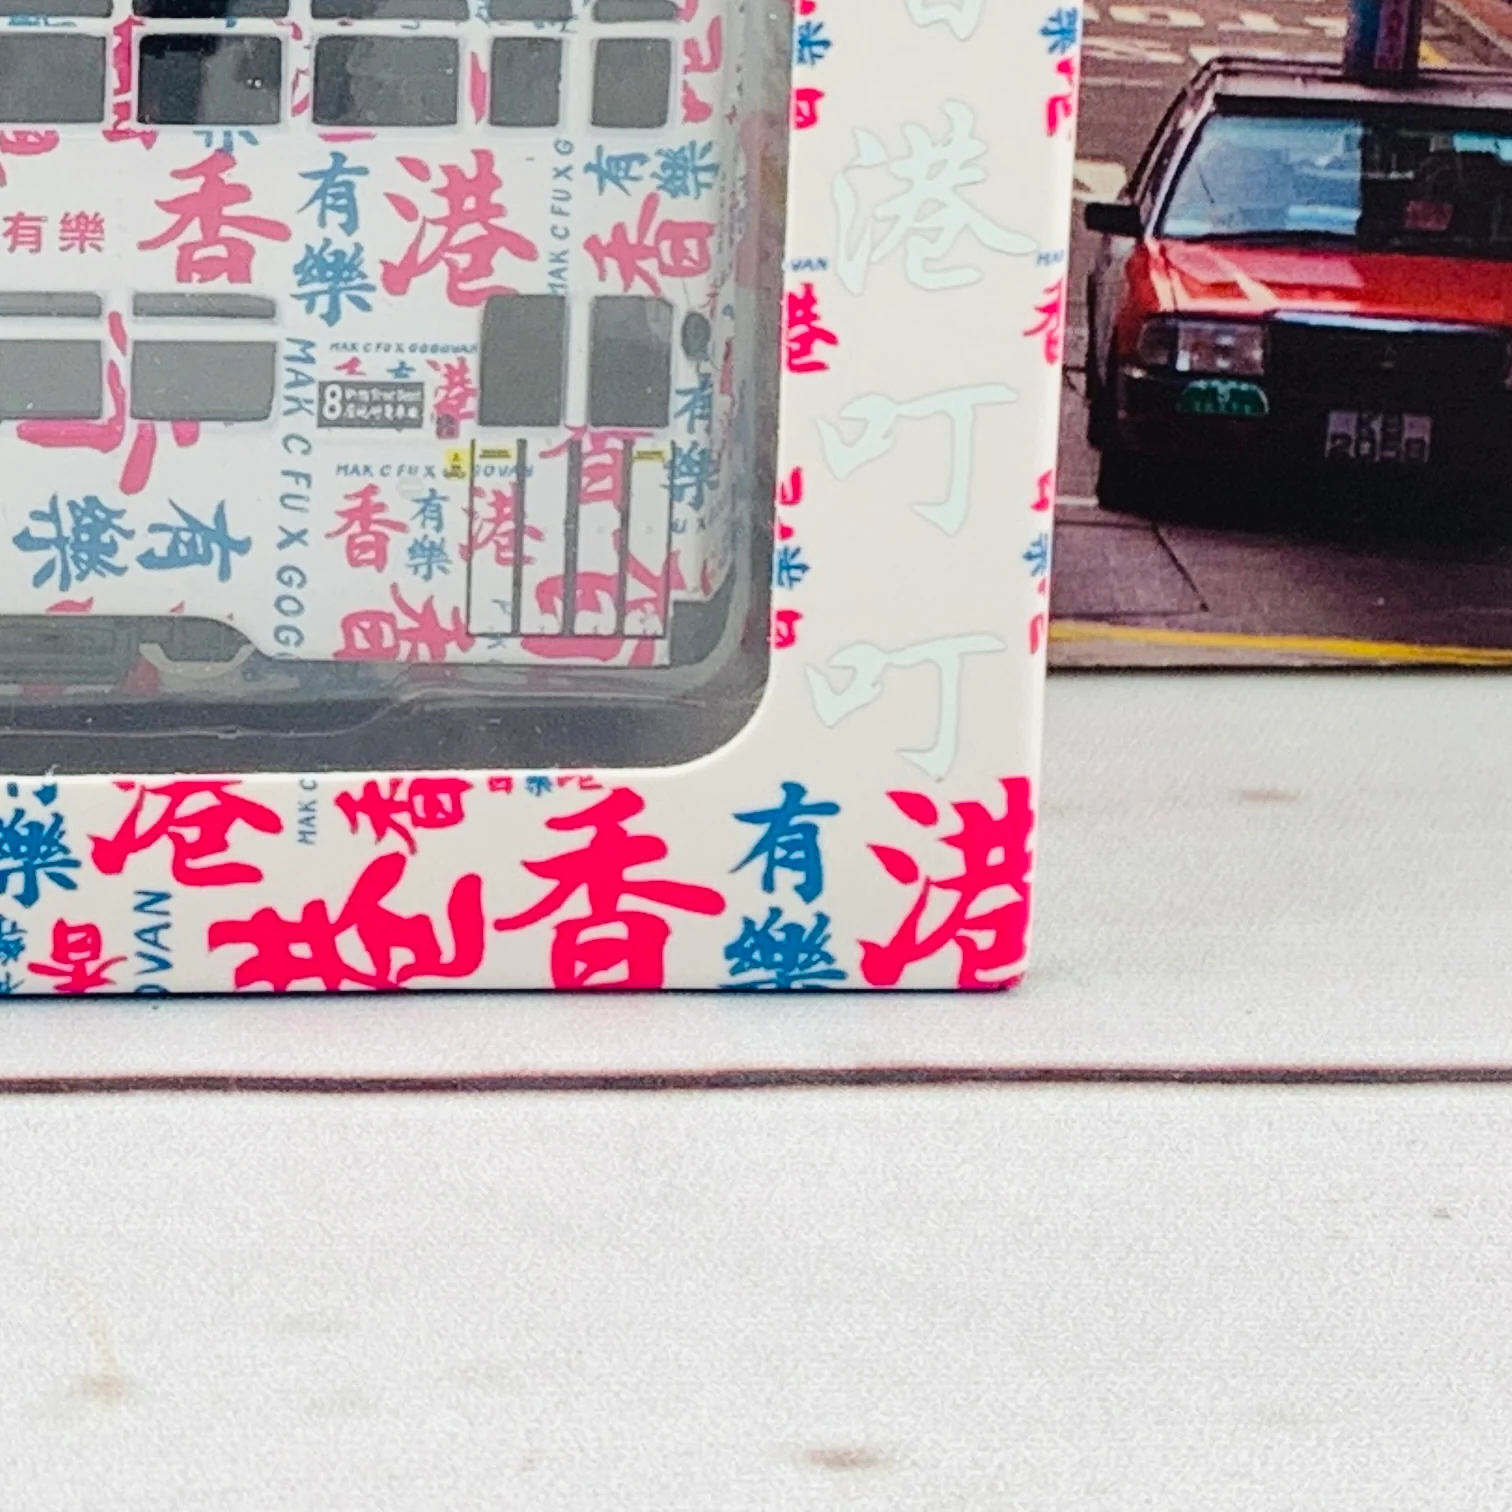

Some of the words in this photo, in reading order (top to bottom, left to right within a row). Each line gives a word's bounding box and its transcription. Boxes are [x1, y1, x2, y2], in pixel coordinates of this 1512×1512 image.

[136, 147, 293, 285] 香
[379, 148, 541, 308] 港
[284, 337, 317, 417] MAK
[323, 382, 343, 421] 8
[282, 433, 314, 456] C
[279, 468, 312, 515] FU
[335, 464, 375, 478] MAK
[379, 464, 392, 478] C
[396, 464, 419, 478] FU
[423, 464, 437, 478] X
[276, 524, 310, 550] X
[325, 483, 410, 574] 香
[492, 787, 727, 992] 香
[856, 775, 1035, 993] 港
